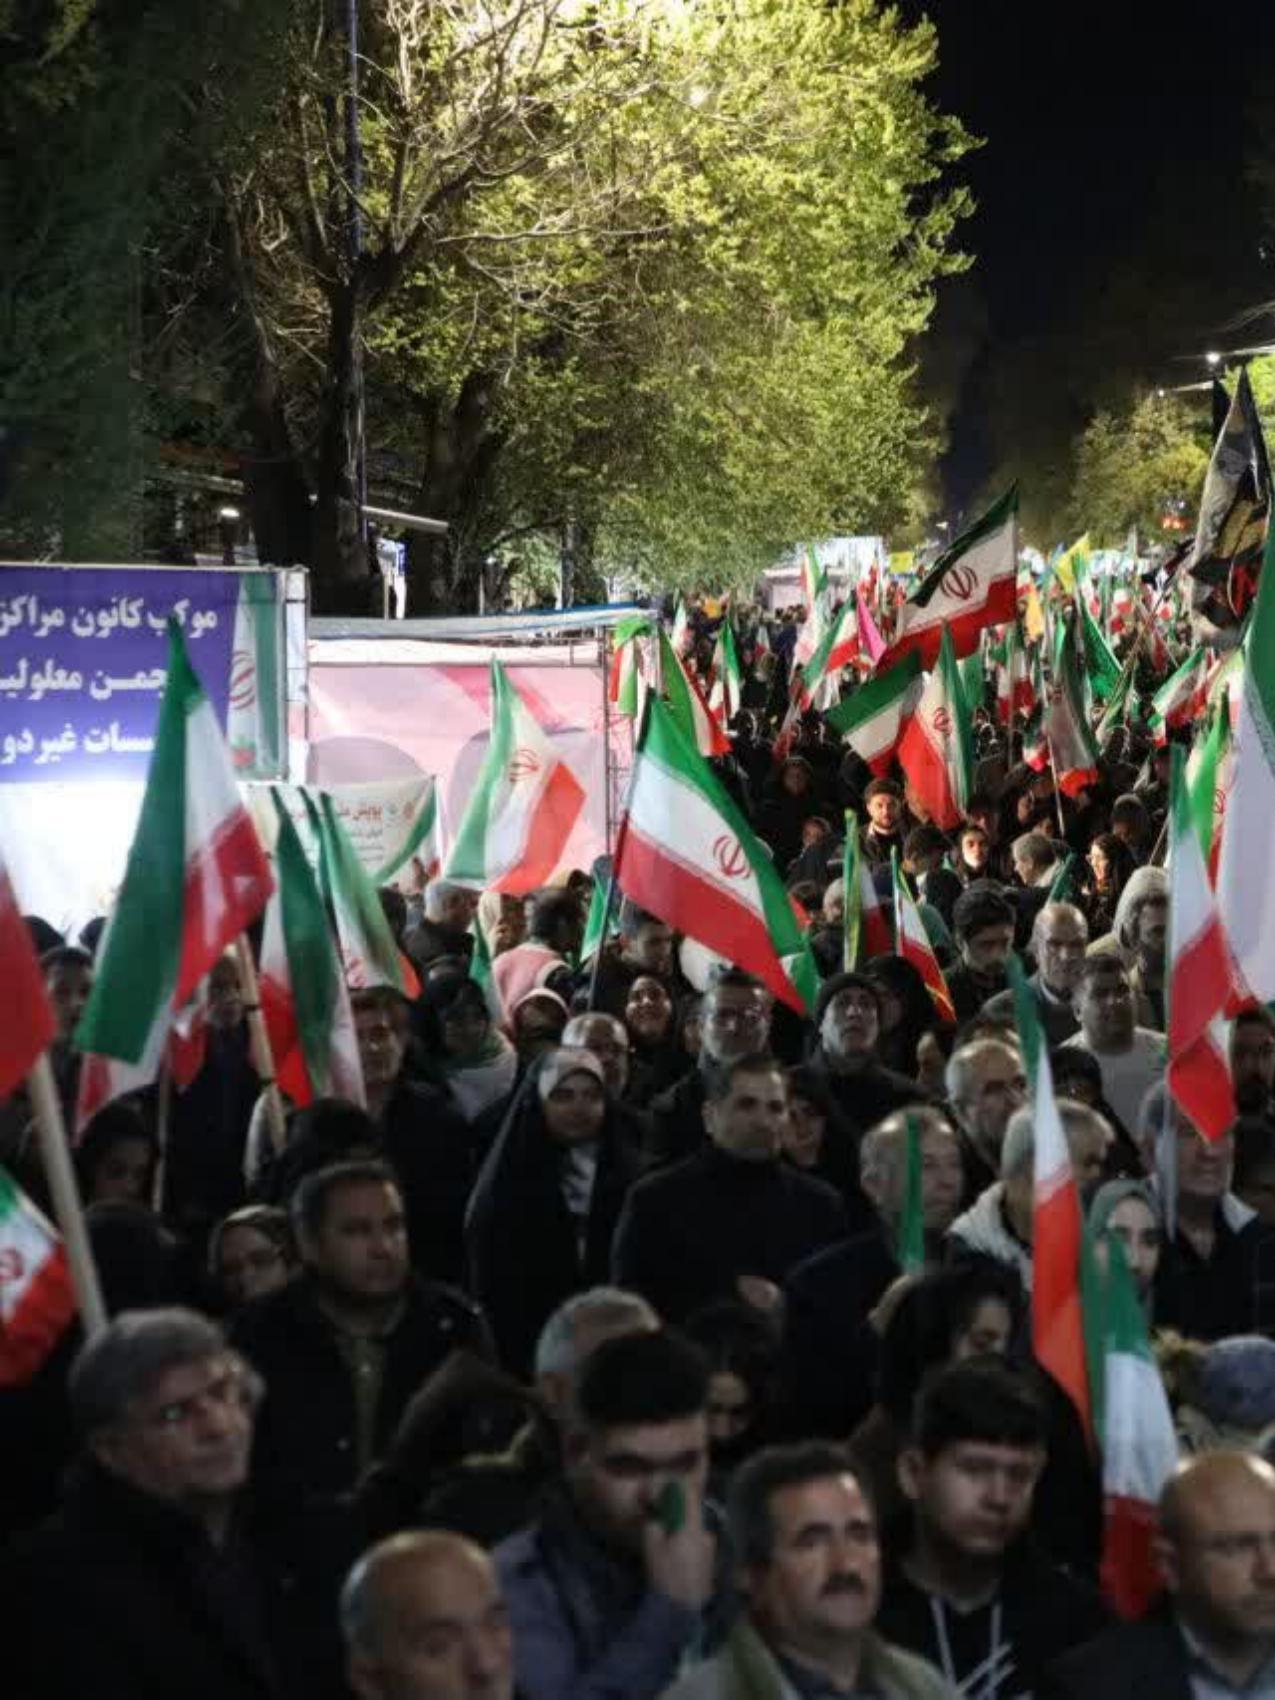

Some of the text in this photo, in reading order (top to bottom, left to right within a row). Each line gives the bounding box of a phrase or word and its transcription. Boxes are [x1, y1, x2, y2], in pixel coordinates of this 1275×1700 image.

[72, 597, 144, 637] کانون
[0, 658, 167, 700] جمن معلولی
